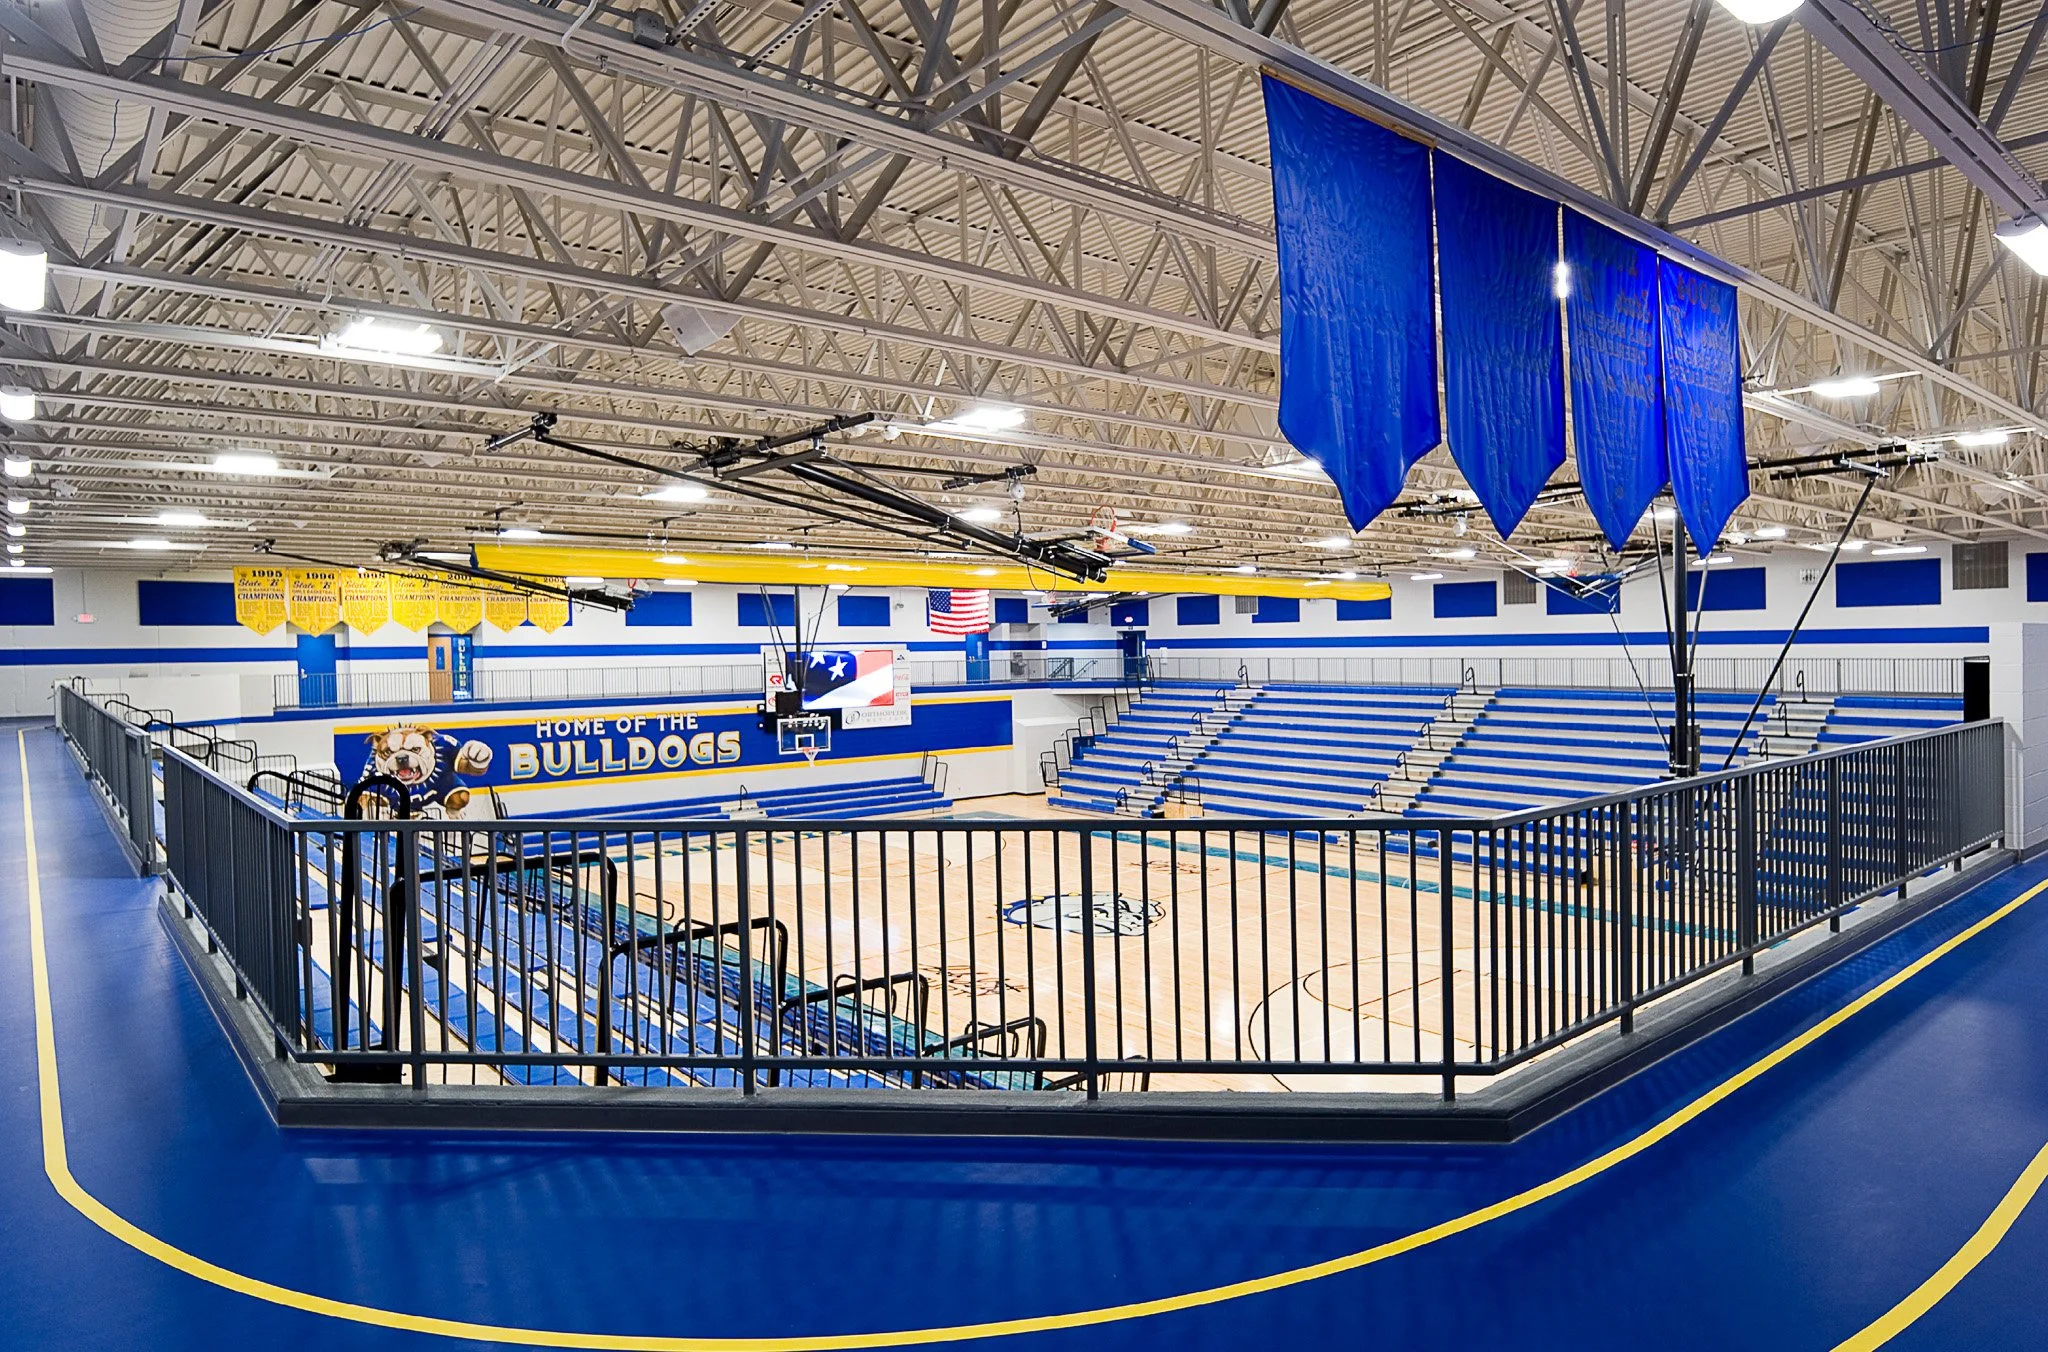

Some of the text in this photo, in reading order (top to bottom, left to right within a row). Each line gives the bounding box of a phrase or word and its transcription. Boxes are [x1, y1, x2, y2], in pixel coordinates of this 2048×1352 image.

[252, 570, 283, 578] 1995
[306, 572, 335, 580] 1996
[239, 578, 261, 587] State
[292, 580, 315, 589] State
[536, 712, 699, 739] HOME OF THE
[508, 730, 741, 780] BULLDOGS
